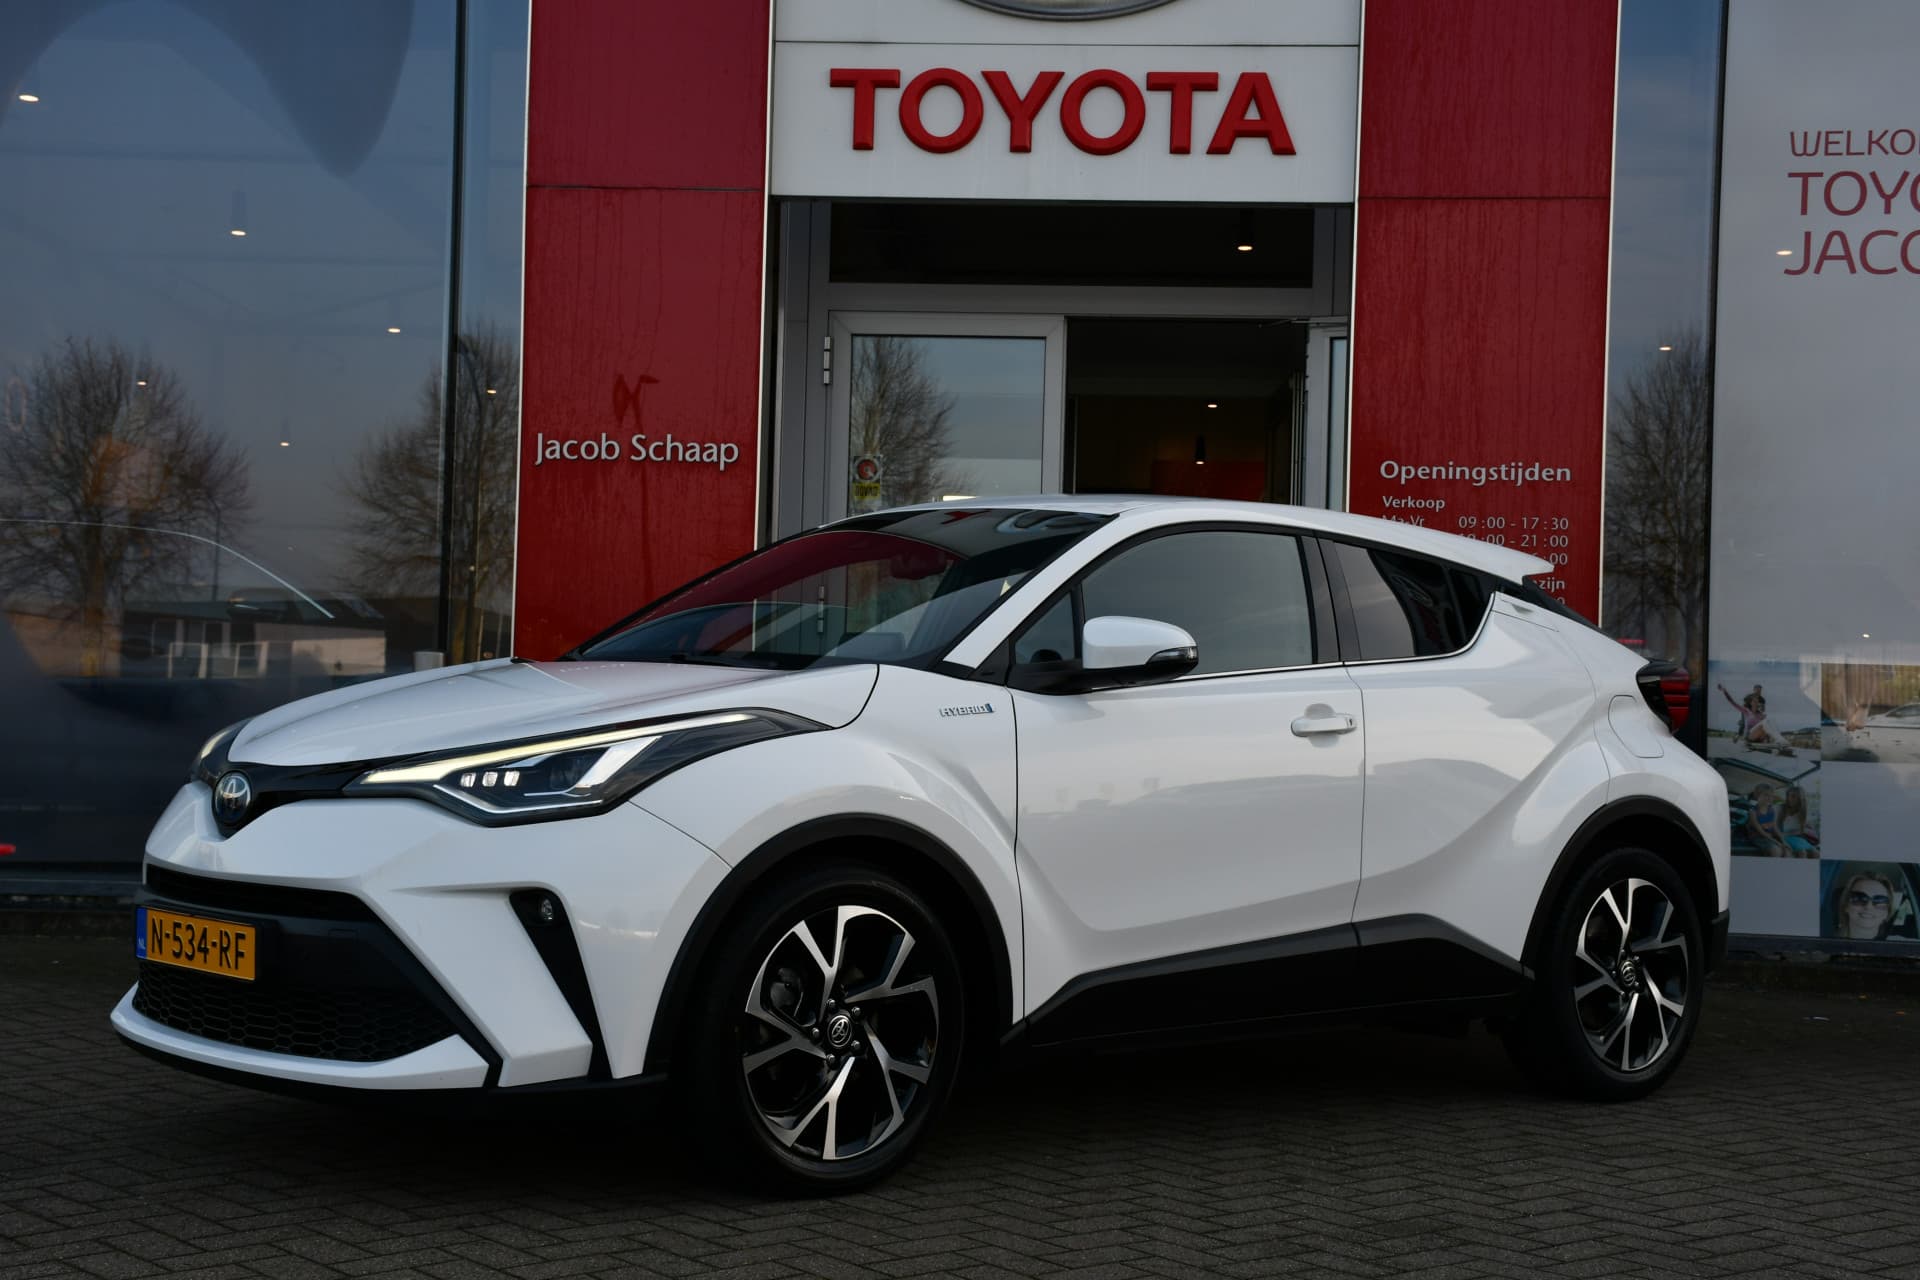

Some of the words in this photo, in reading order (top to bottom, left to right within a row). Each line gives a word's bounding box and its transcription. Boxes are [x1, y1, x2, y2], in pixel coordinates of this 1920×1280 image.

[829, 67, 1297, 155] TOYOTA
[1789, 129, 1920, 157] WELKO
[1787, 170, 1920, 216] TOY
[535, 432, 621, 466] Jacob
[630, 433, 740, 472] Schaap
[1379, 459, 1572, 486] Openingstijden
[1382, 495, 1446, 512] Verkoop
[151, 916, 246, 970] N-534-RF
